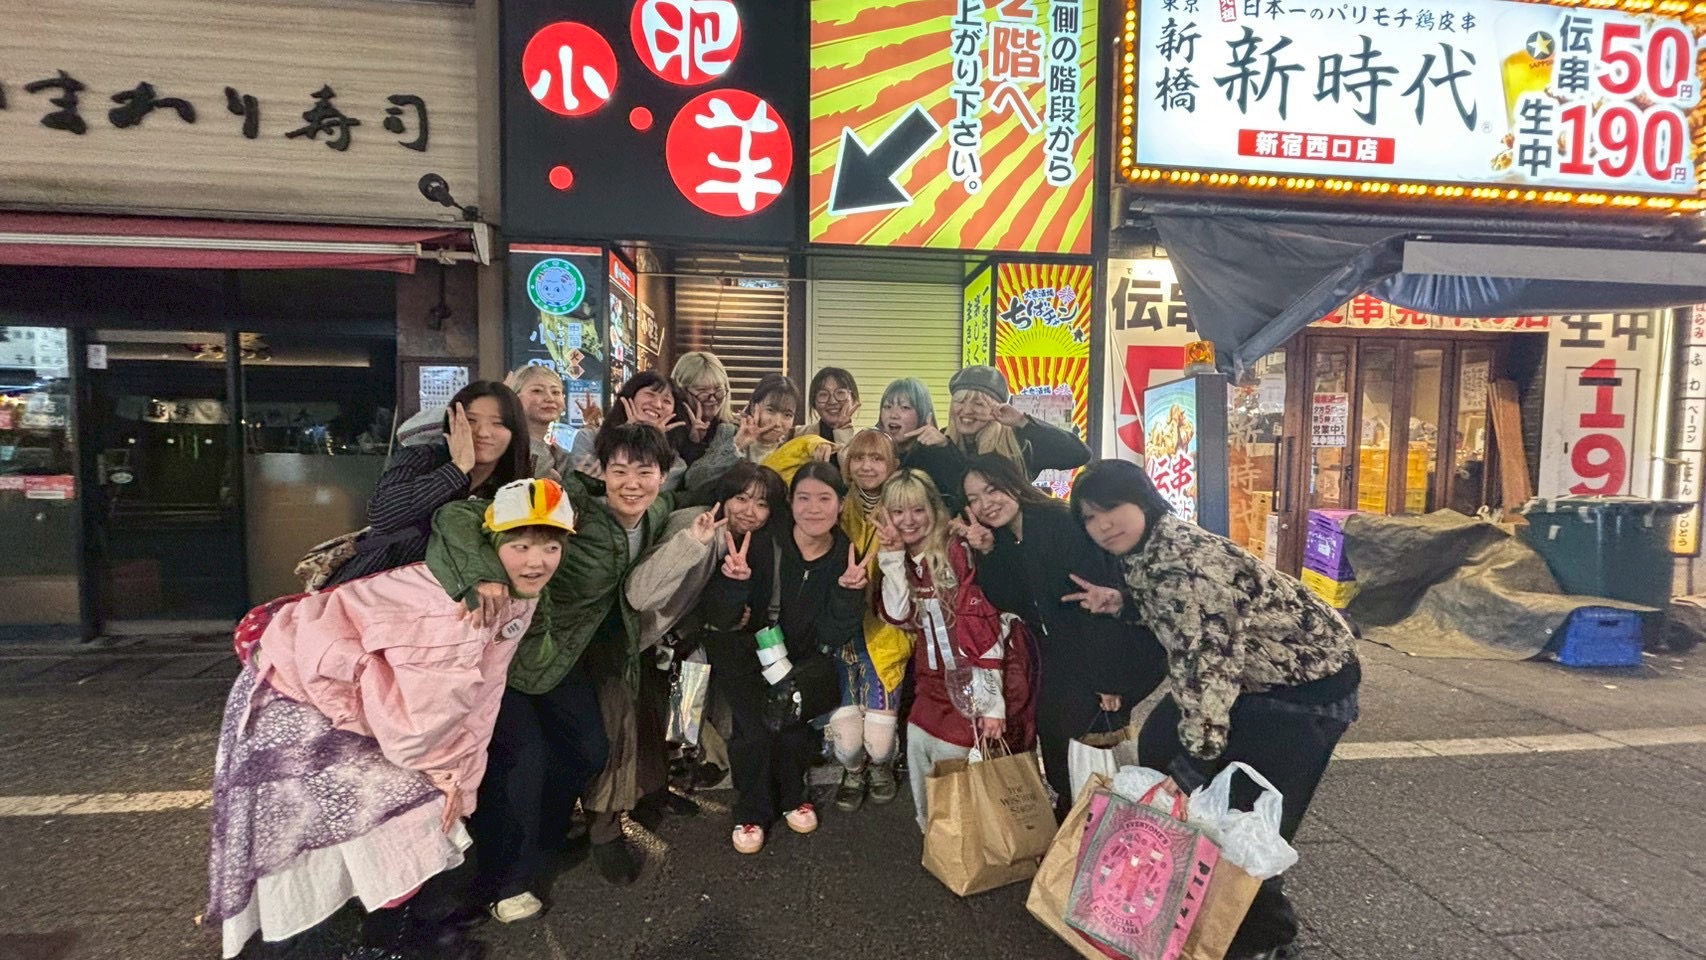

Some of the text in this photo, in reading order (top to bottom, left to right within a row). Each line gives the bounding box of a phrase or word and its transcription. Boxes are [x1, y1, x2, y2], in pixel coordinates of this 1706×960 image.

[1242, 0, 1477, 33] 日本一のパリモチ鶏皮串
[1557, 15, 1594, 93] 伝串
[1047, 0, 1079, 182] 側の階段から
[1155, 17, 1202, 113] 新橋
[1213, 25, 1478, 131] 新時代
[0, 69, 429, 152] まわり寿司
[1256, 132, 1379, 161] 新宿西口店
[1518, 98, 1553, 177] 生中
[1685, 405, 1699, 443] ベーコン
